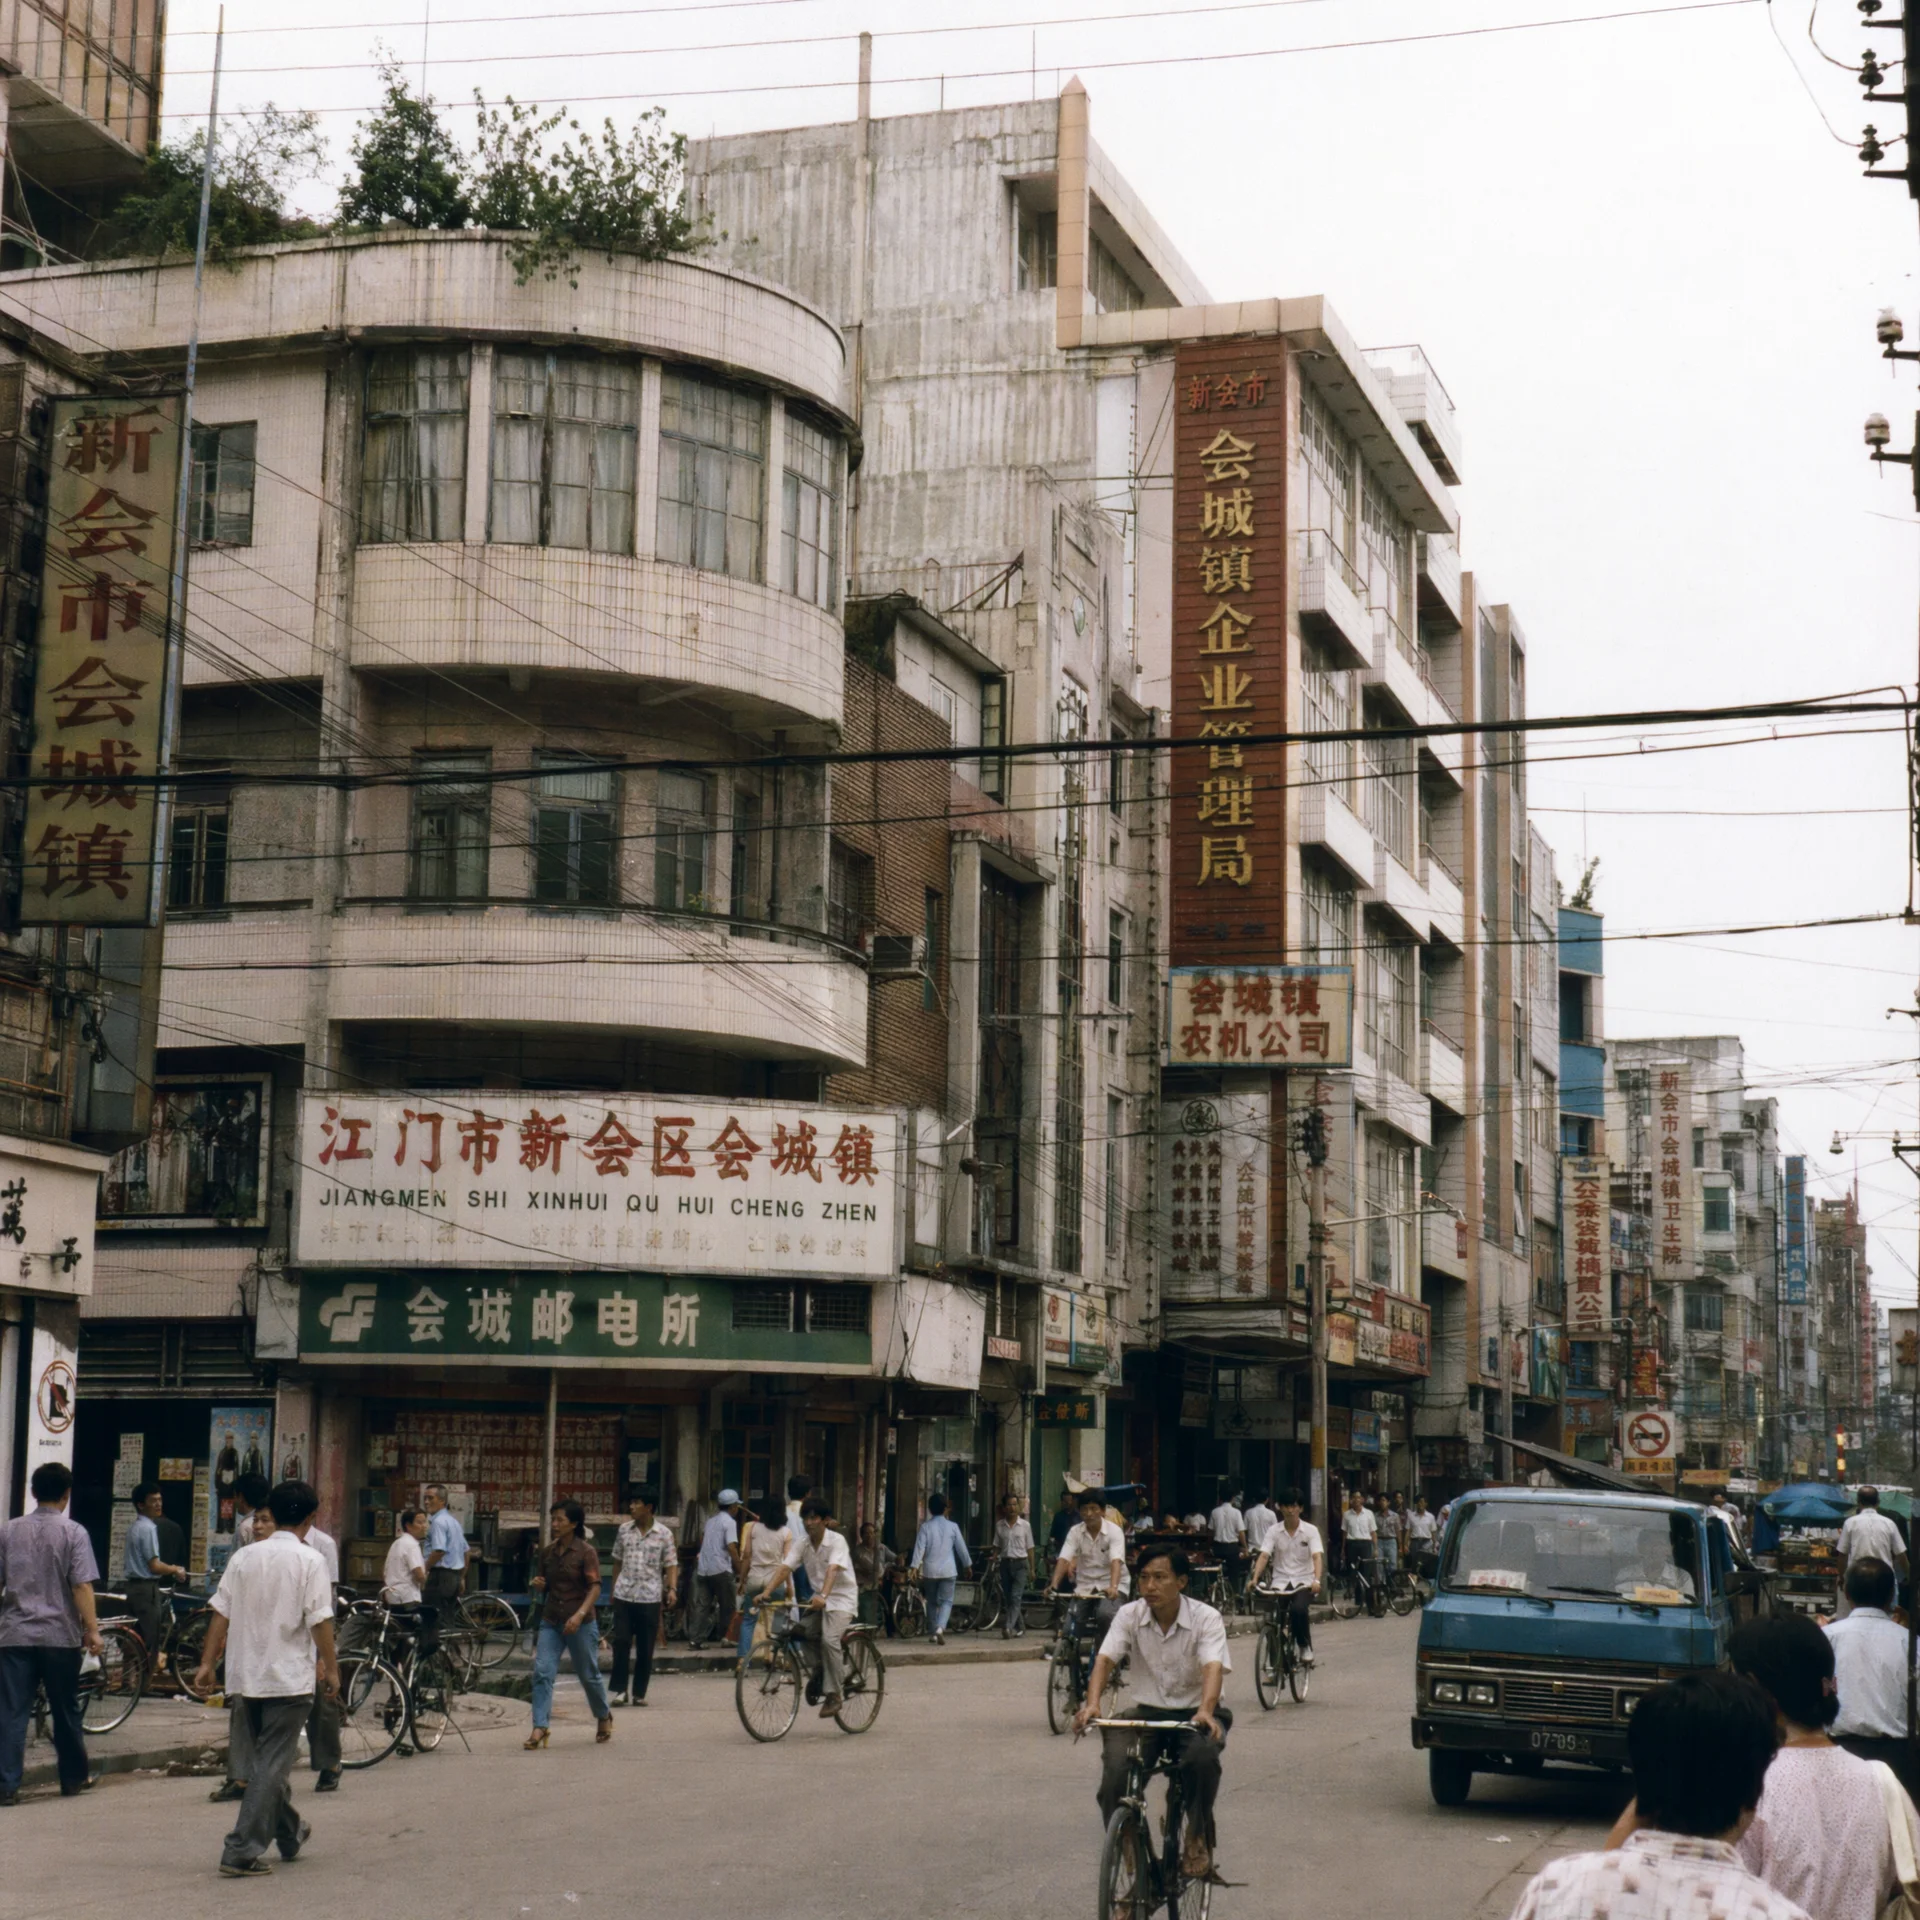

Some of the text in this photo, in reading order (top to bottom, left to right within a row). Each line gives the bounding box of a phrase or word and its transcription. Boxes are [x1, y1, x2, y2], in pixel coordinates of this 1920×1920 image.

[1188, 370, 1268, 409] 新会市
[33, 405, 163, 900] 新会市会城镇
[1197, 428, 1255, 887] 会城镇企业管理局
[1188, 976, 1321, 1017] 会城镇
[1180, 1021, 1332, 1060] 农机公司
[318, 1106, 879, 1186] 江门市新会区会城镇
[1660, 1071, 1682, 1265] 新会市会城镇卫生院
[319, 1189, 877, 1222] JIANGMEN SHI XINHUI QU HUI CHENG ZHEN
[405, 1285, 699, 1348] 会城邮电所
